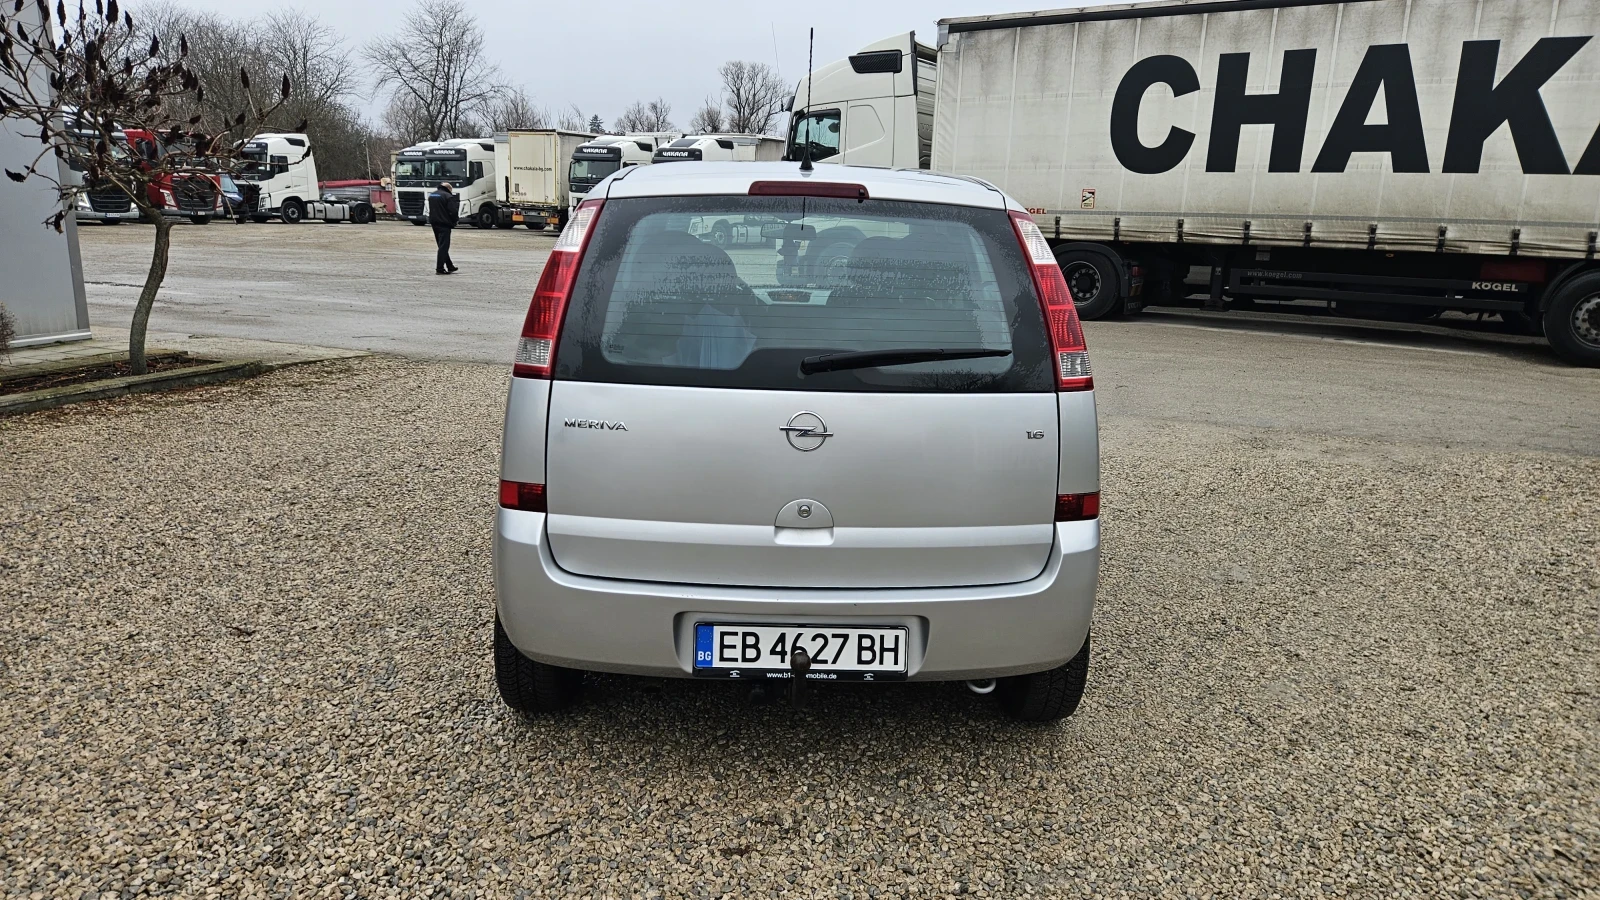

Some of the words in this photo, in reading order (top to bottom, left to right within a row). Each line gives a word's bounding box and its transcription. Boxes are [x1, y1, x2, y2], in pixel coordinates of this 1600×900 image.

[1110, 35, 1600, 175] CHAK
[1247, 271, 1302, 279] www.koegel.com
[1471, 281, 1519, 292] KÖGEL
[564, 417, 629, 431] MERIVA
[719, 631, 762, 663] EB
[769, 632, 850, 665] 4627
[856, 634, 900, 666] BH
[697, 651, 712, 661] BG
